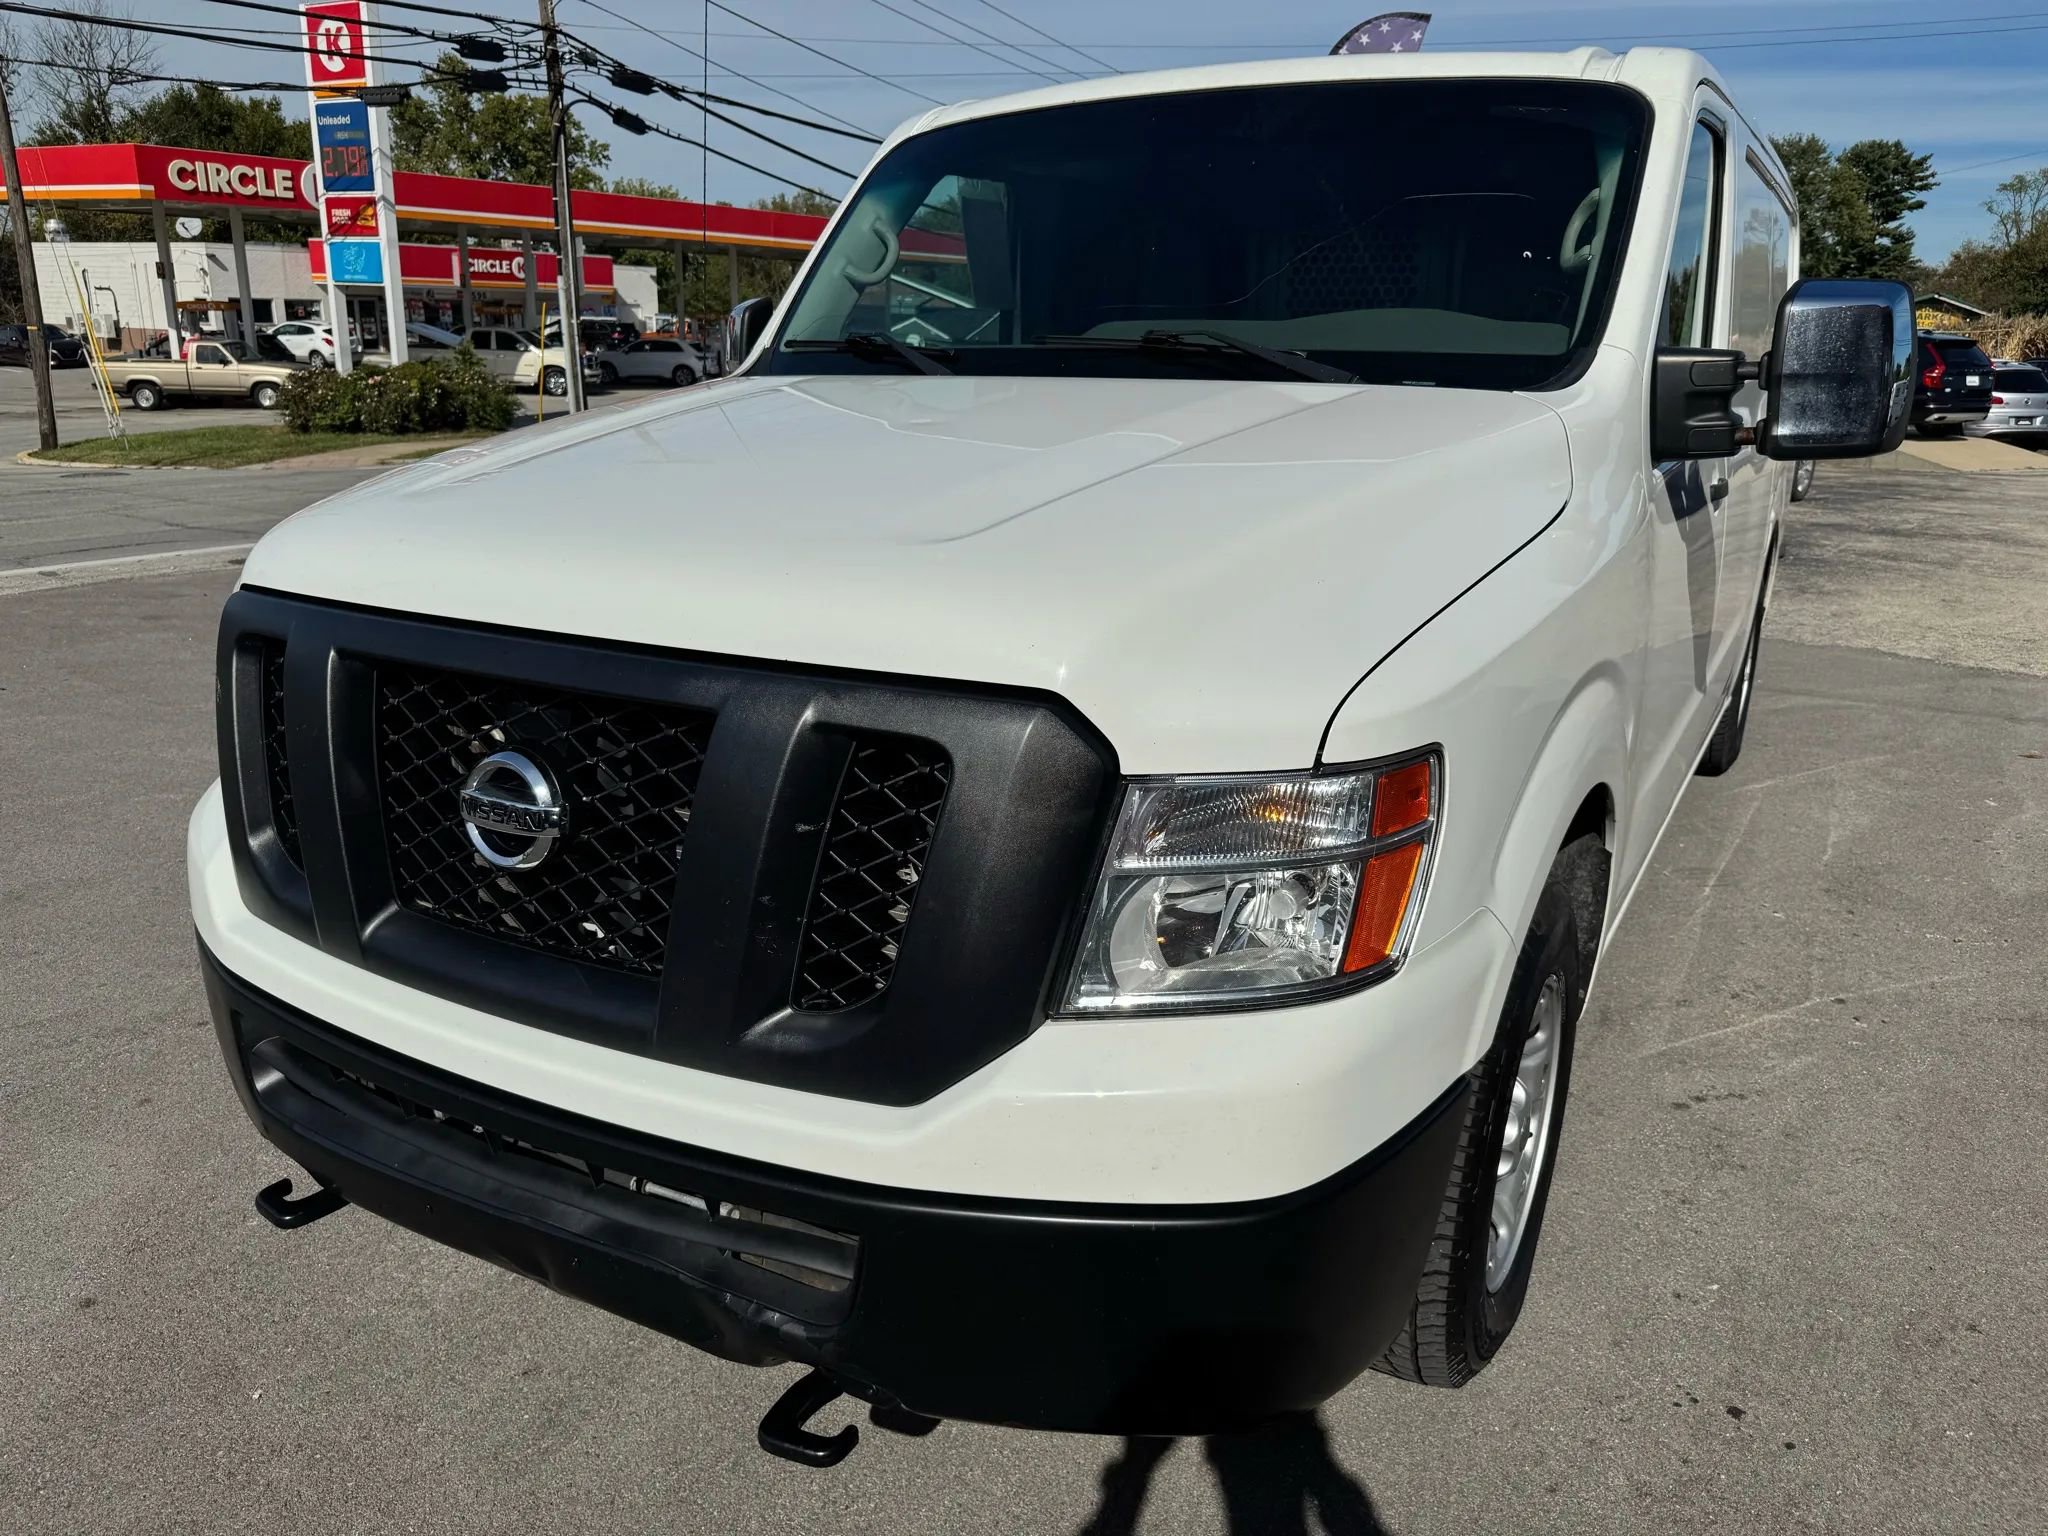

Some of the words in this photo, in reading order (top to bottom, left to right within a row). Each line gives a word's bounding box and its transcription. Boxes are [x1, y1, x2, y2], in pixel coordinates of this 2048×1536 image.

[318, 114, 351, 126] Unleaded
[168, 159, 295, 199] CIRCLE
[331, 208, 352, 217] FRESH
[469, 258, 511, 273] CIRCLE
[462, 797, 545, 832] NISSAN
